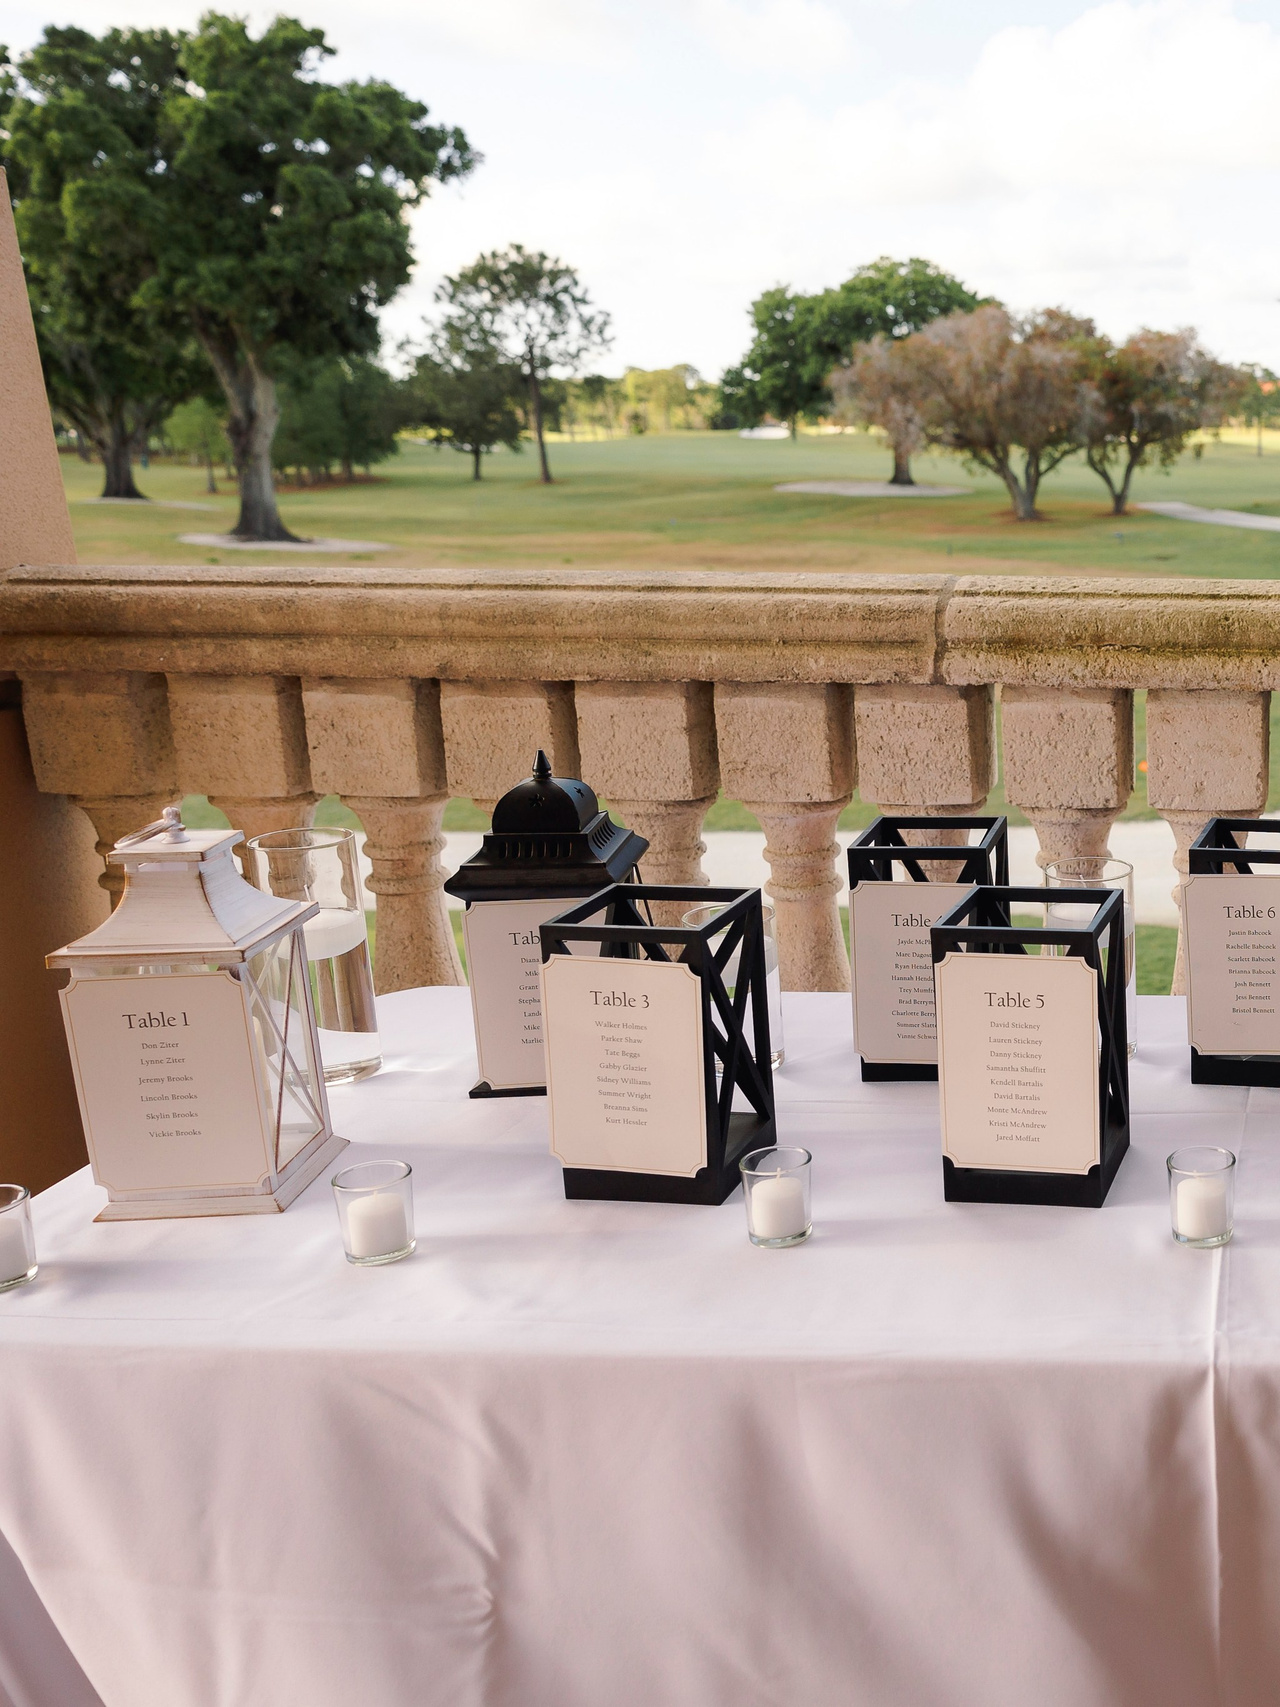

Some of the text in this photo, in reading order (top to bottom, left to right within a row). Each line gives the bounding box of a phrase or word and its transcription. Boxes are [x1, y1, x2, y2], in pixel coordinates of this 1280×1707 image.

[1222, 905, 1276, 919] Table 6
[890, 913, 931, 927] Table
[894, 963, 910, 971] Ryan
[1233, 981, 1248, 989] Josh
[589, 990, 650, 1009] Table 3
[983, 991, 1045, 1009] Table 5
[1235, 994, 1247, 1002] Jess
[121, 1011, 190, 1029] Table 1
[594, 1021, 621, 1029] Walker
[1011, 1022, 1041, 1031] Stickney
[601, 1035, 643, 1044] Parker Shaw
[989, 1036, 1043, 1047] Lauren Stickney
[621, 1050, 641, 1059] Beggs
[990, 1050, 1042, 1061] Danny Stickney
[140, 1059, 164, 1067] Lynne
[599, 1062, 647, 1072] Gabby Glazier
[986, 1064, 1046, 1074] Samantha Shuffitt
[138, 1077, 165, 1086] Jeremy
[597, 1076, 651, 1086] Sidney Williams
[990, 1078, 1016, 1086] Kendell
[140, 1092, 198, 1102] Lincoln Brooks
[598, 1089, 651, 1101] Summer Wright
[994, 1092, 1041, 1101] David Bartalis
[603, 1103, 630, 1111] Breanna
[987, 1106, 1048, 1115] Monte McAndrew
[146, 1111, 199, 1121] Skylin Brooks
[623, 1118, 647, 1126] Hessler
[1009, 1121, 1047, 1129] McAndrew
[148, 1130, 174, 1138] Vickie
[995, 1134, 1014, 1142] Jared
